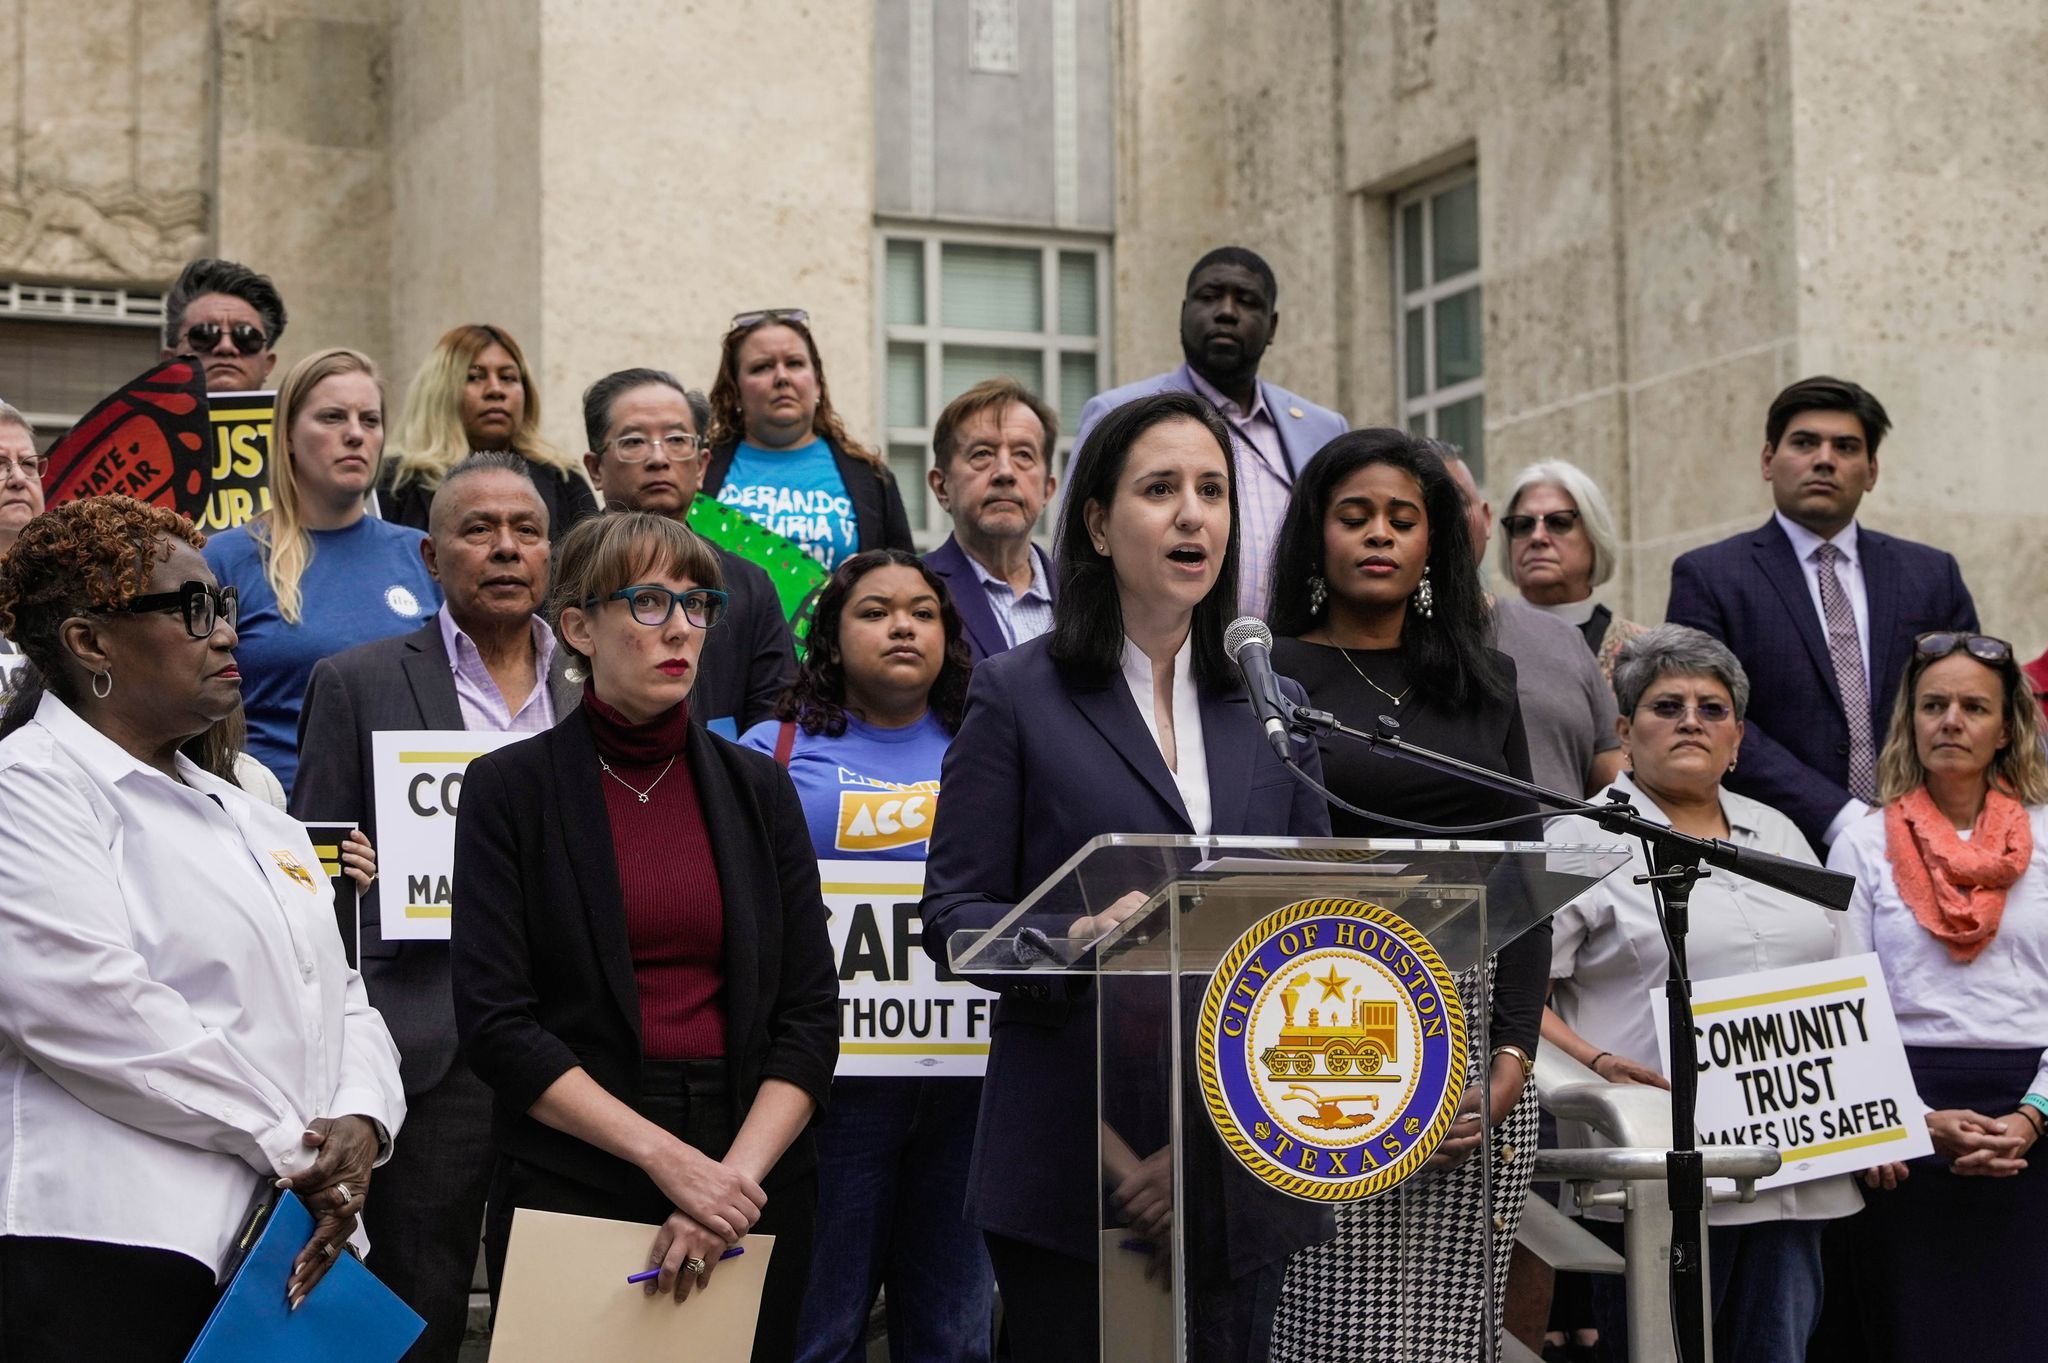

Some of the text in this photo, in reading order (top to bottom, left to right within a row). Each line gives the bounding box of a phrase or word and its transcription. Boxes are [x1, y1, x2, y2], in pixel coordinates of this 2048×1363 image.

[74, 446, 126, 500] HATE
[106, 460, 160, 498] EAR
[195, 488, 253, 530] UR
[845, 796, 927, 837] ACC
[408, 874, 452, 904] MA
[824, 903, 966, 982] AF
[1222, 923, 1445, 1038] CITY OF HOUSTON
[967, 999, 997, 1038] F
[1694, 997, 1868, 1072] COMMUNITY
[1735, 1056, 1836, 1116] TRUST
[1783, 1115, 1815, 1147] US
[1820, 1098, 1902, 1140] SAFER
[1271, 1132, 1402, 1175] TEXAS
